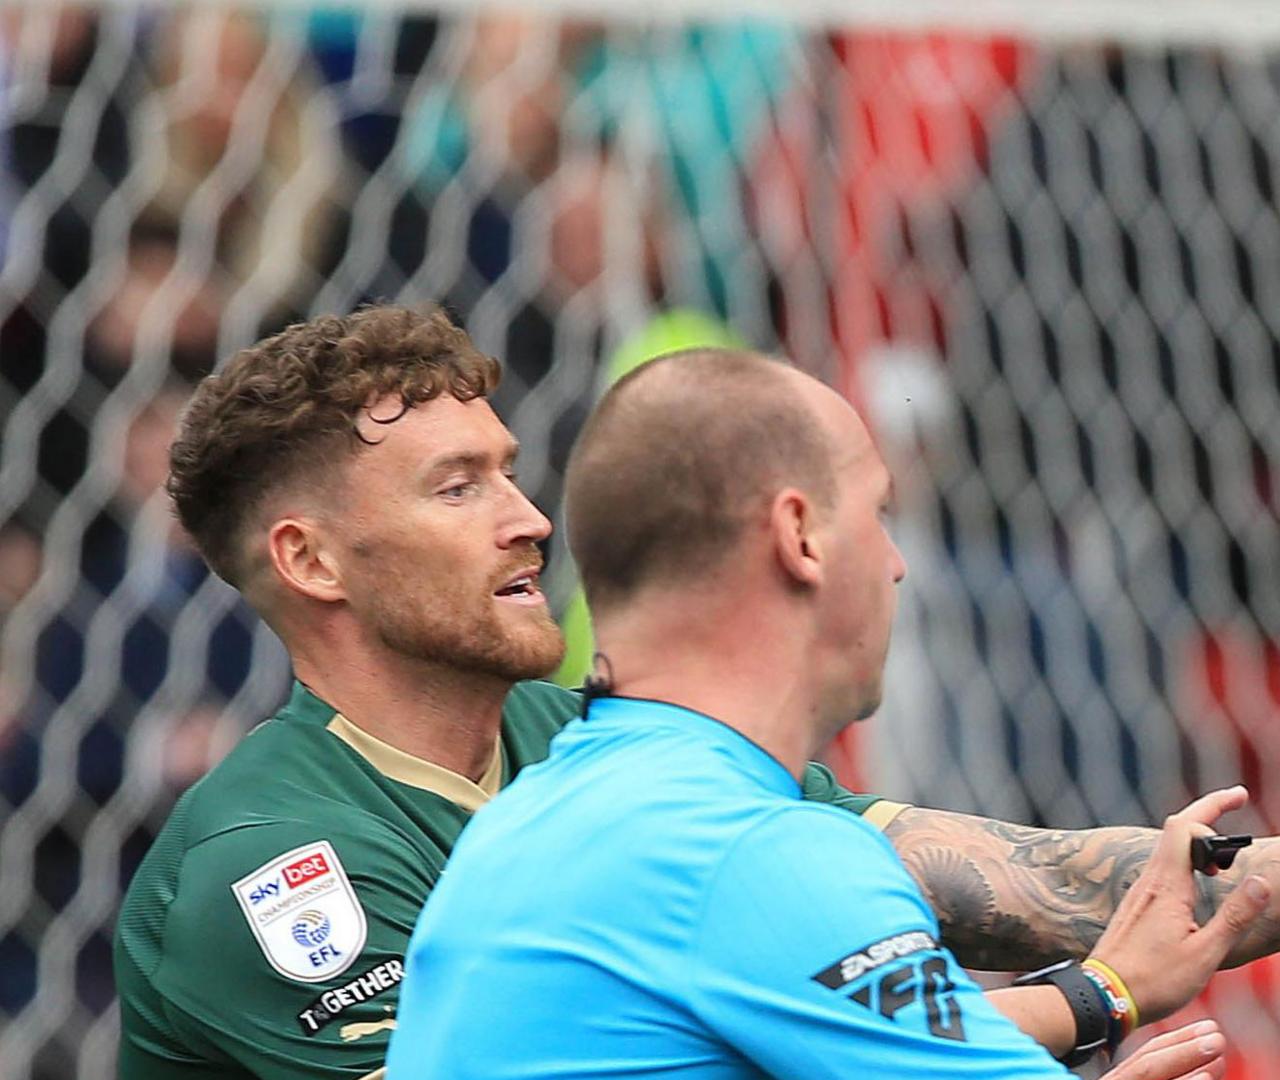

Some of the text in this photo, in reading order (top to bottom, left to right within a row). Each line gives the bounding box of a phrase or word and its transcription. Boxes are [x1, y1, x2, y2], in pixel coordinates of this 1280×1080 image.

[249, 854, 328, 906] sky bet
[308, 943, 342, 968] EFL
